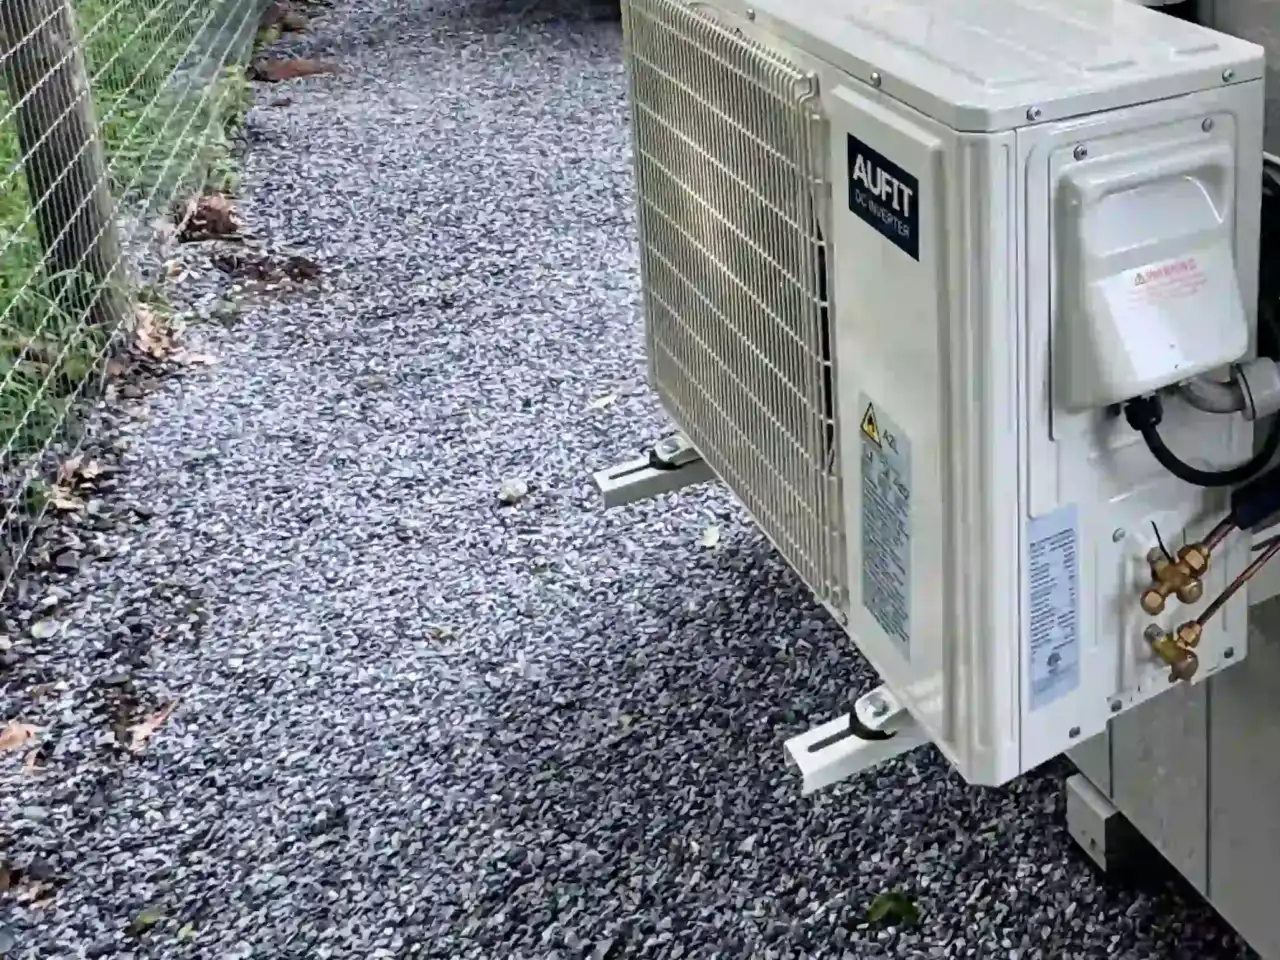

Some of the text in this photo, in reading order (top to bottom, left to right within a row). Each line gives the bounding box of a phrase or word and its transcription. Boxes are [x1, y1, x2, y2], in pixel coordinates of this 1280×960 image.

[852, 153, 913, 218] AUFIT
[854, 188, 868, 209] DC
[868, 200, 911, 239] INVERTER
